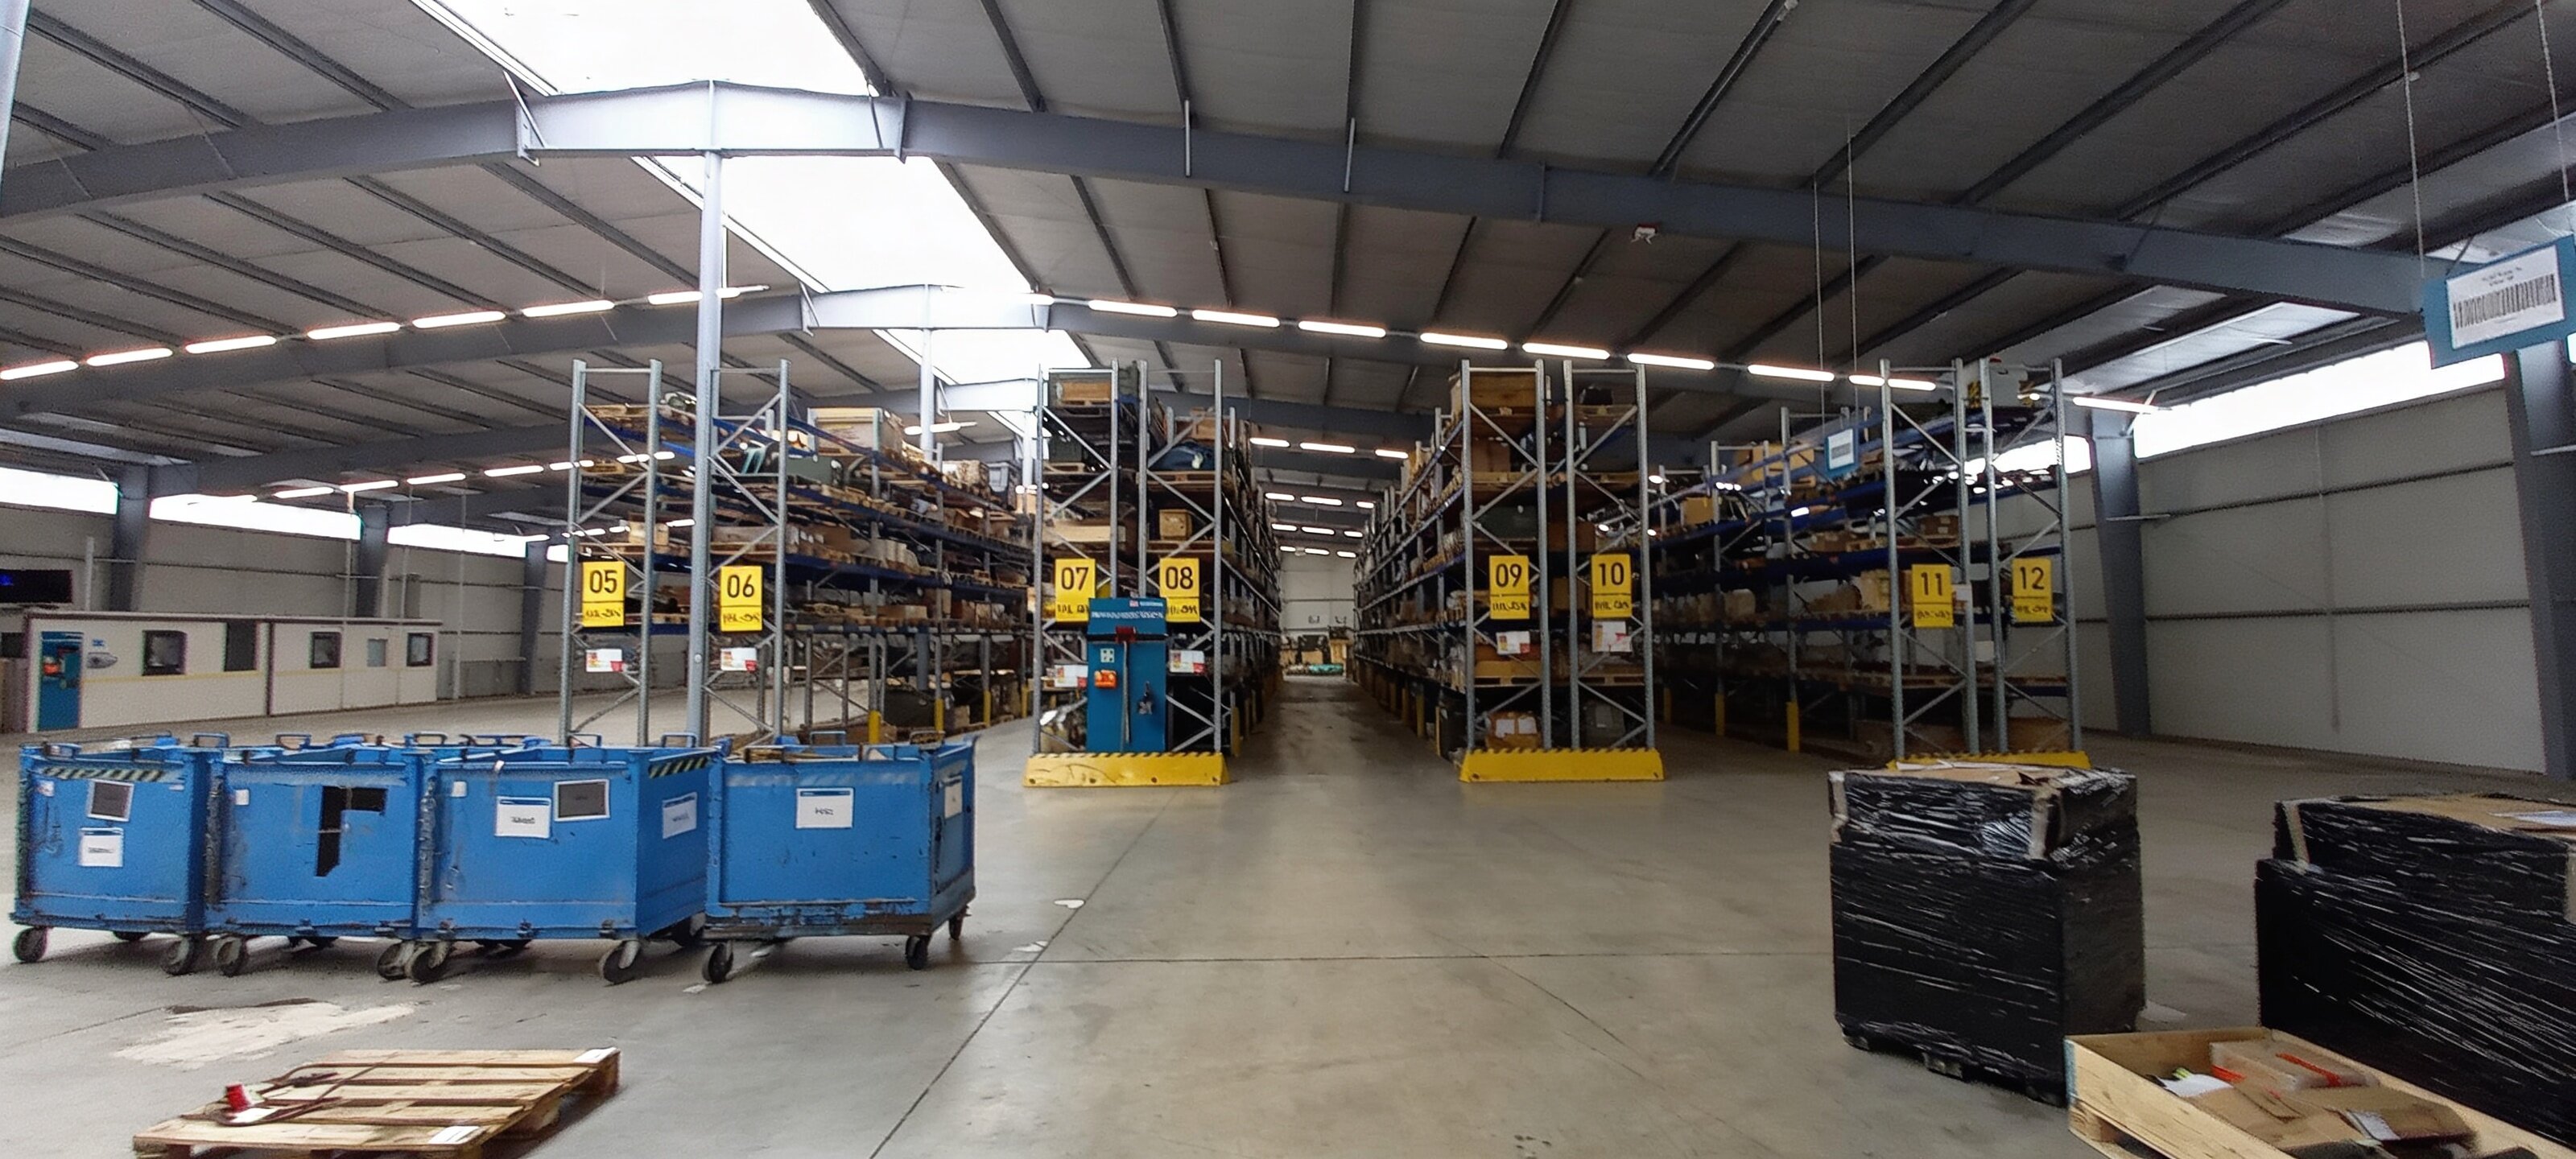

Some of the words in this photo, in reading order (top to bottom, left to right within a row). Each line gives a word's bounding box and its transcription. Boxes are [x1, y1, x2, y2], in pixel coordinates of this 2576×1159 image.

[589, 569, 617, 594] 05
[727, 574, 755, 599] 06
[1061, 567, 1089, 591] 07
[1165, 566, 1194, 590] 08
[1495, 563, 1522, 588] 09
[1599, 562, 1624, 587] 10
[1921, 572, 1942, 596] 11
[2019, 567, 2045, 590] 12
